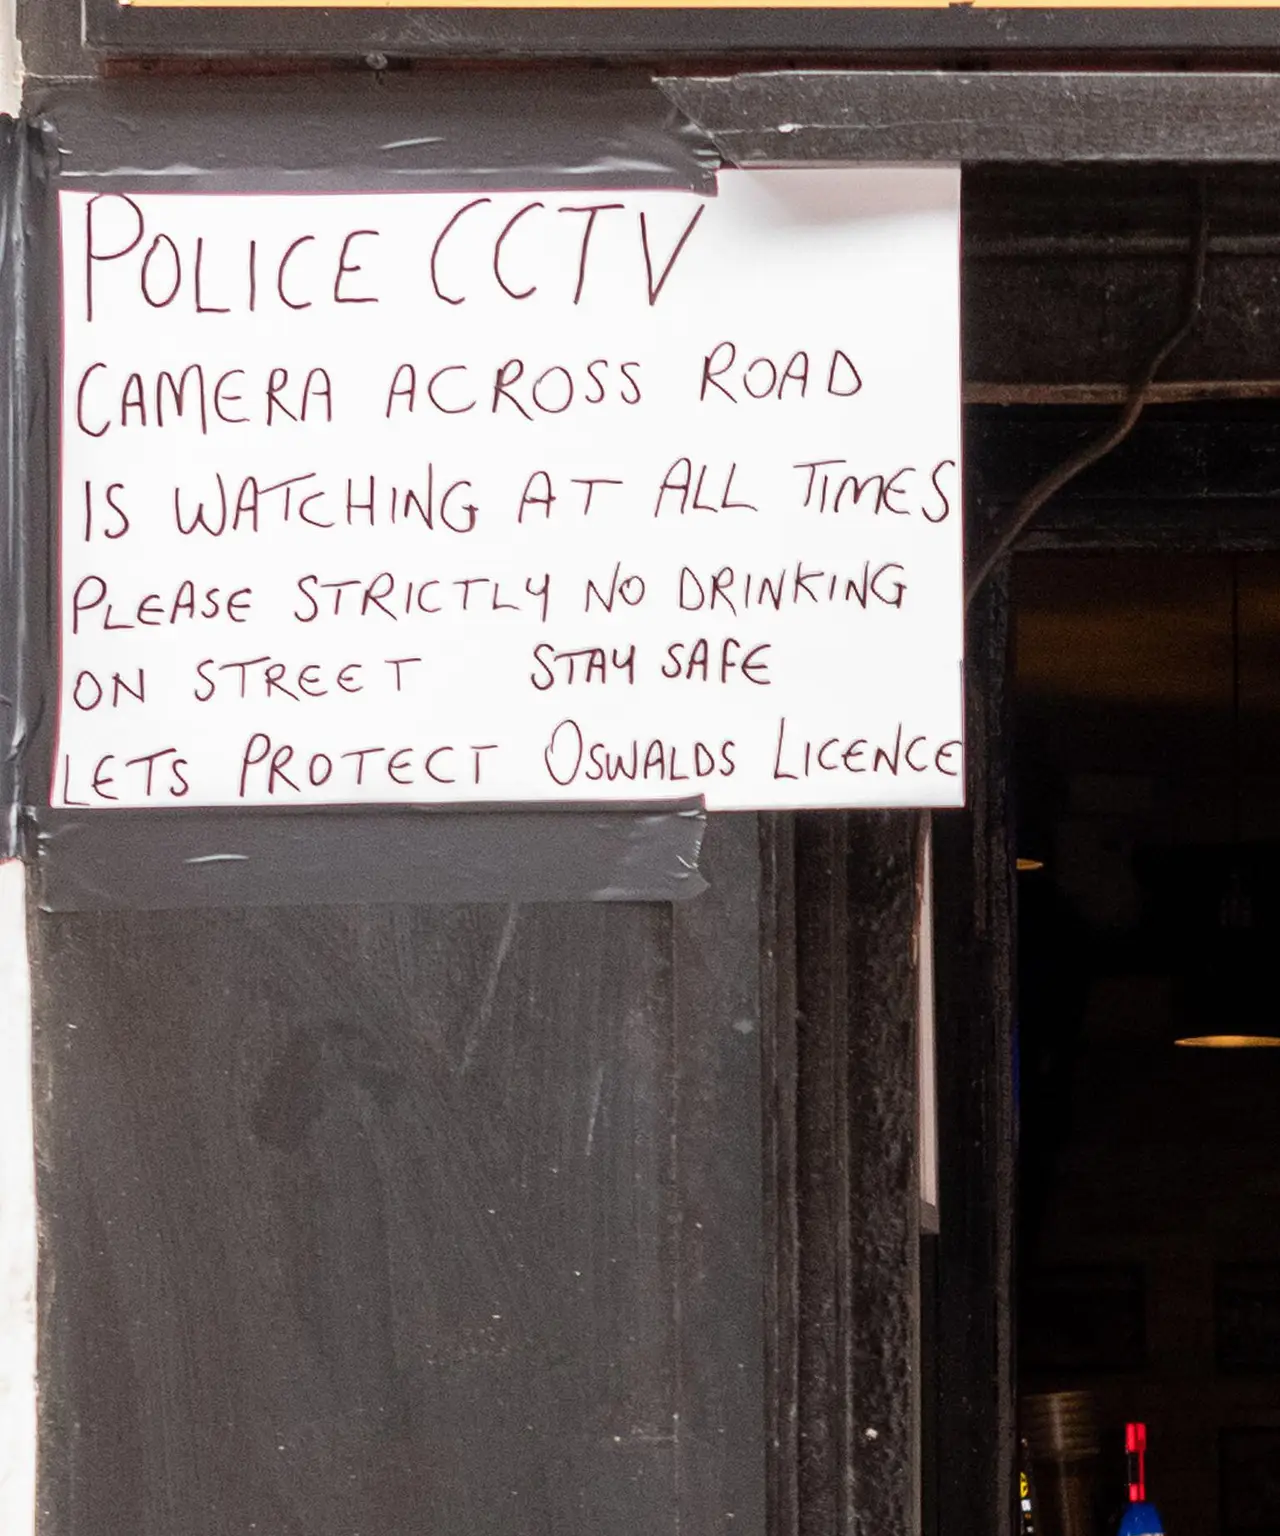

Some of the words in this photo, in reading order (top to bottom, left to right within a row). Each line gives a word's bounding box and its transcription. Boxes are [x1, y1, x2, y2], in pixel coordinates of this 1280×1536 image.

[86, 193, 380, 321] POLICE
[430, 197, 706, 307] CCTV
[76, 362, 332, 438] CAMERA
[385, 358, 641, 422] ACROSS
[699, 341, 863, 404] ROAD
[84, 480, 130, 542] IS
[174, 462, 479, 537] WATCHING
[517, 470, 624, 524] AT
[654, 457, 758, 518] ALL
[793, 459, 956, 524] TIMES
[72, 575, 252, 635] PLEASE
[294, 572, 550, 623] STRICTLY
[584, 561, 646, 613] NO
[679, 562, 906, 612] DRINKING
[72, 668, 145, 712] ON
[194, 655, 422, 702] STREET
[530, 643, 636, 691] STAY
[661, 637, 772, 686] SAFE
[63, 749, 191, 805] LETS
[239, 732, 498, 798] PROTECT
[544, 719, 736, 786] OSWALDS
[773, 717, 960, 780] LICENCE
